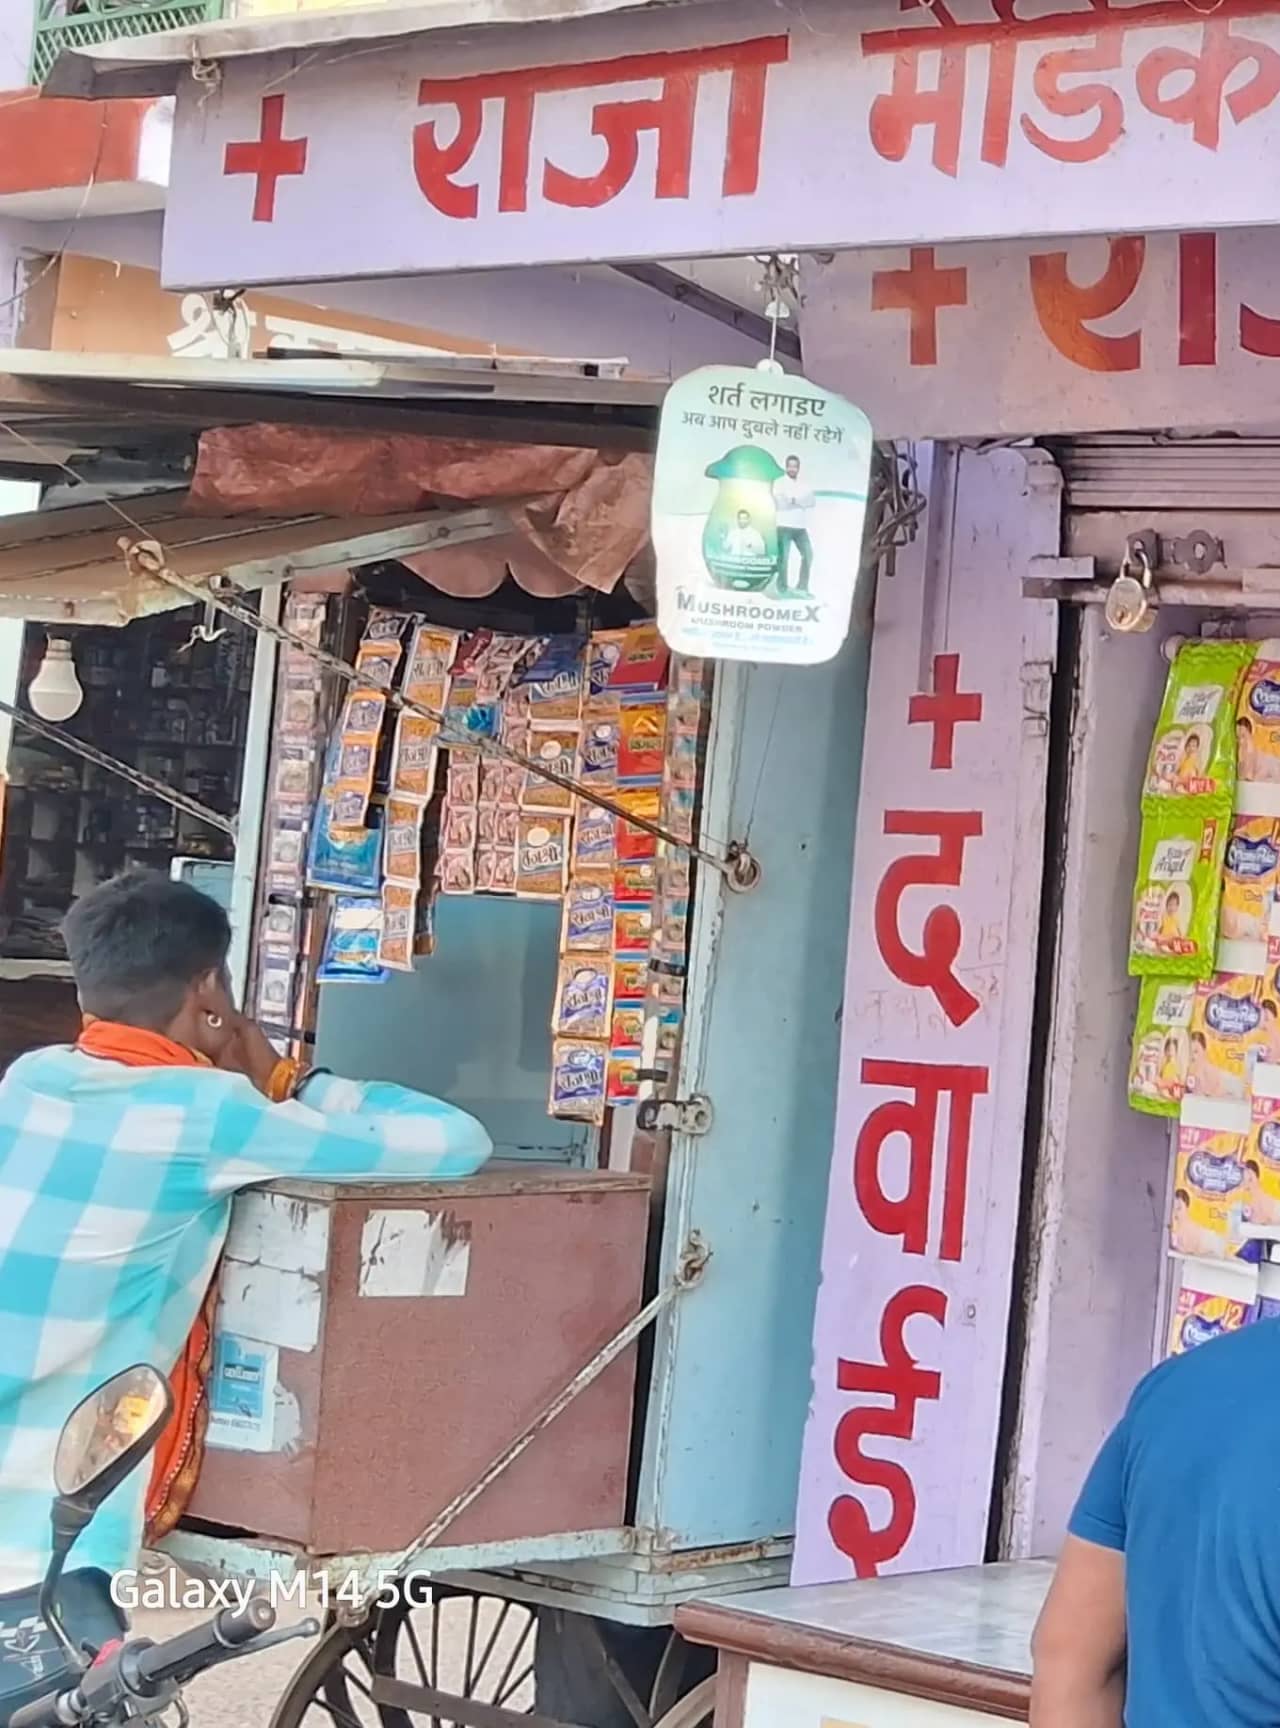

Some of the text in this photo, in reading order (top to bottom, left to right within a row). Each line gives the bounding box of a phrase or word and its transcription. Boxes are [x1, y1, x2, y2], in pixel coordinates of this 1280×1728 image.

[411, 34, 788, 218] राजा
[708, 383, 826, 417] शर्त लगाइए
